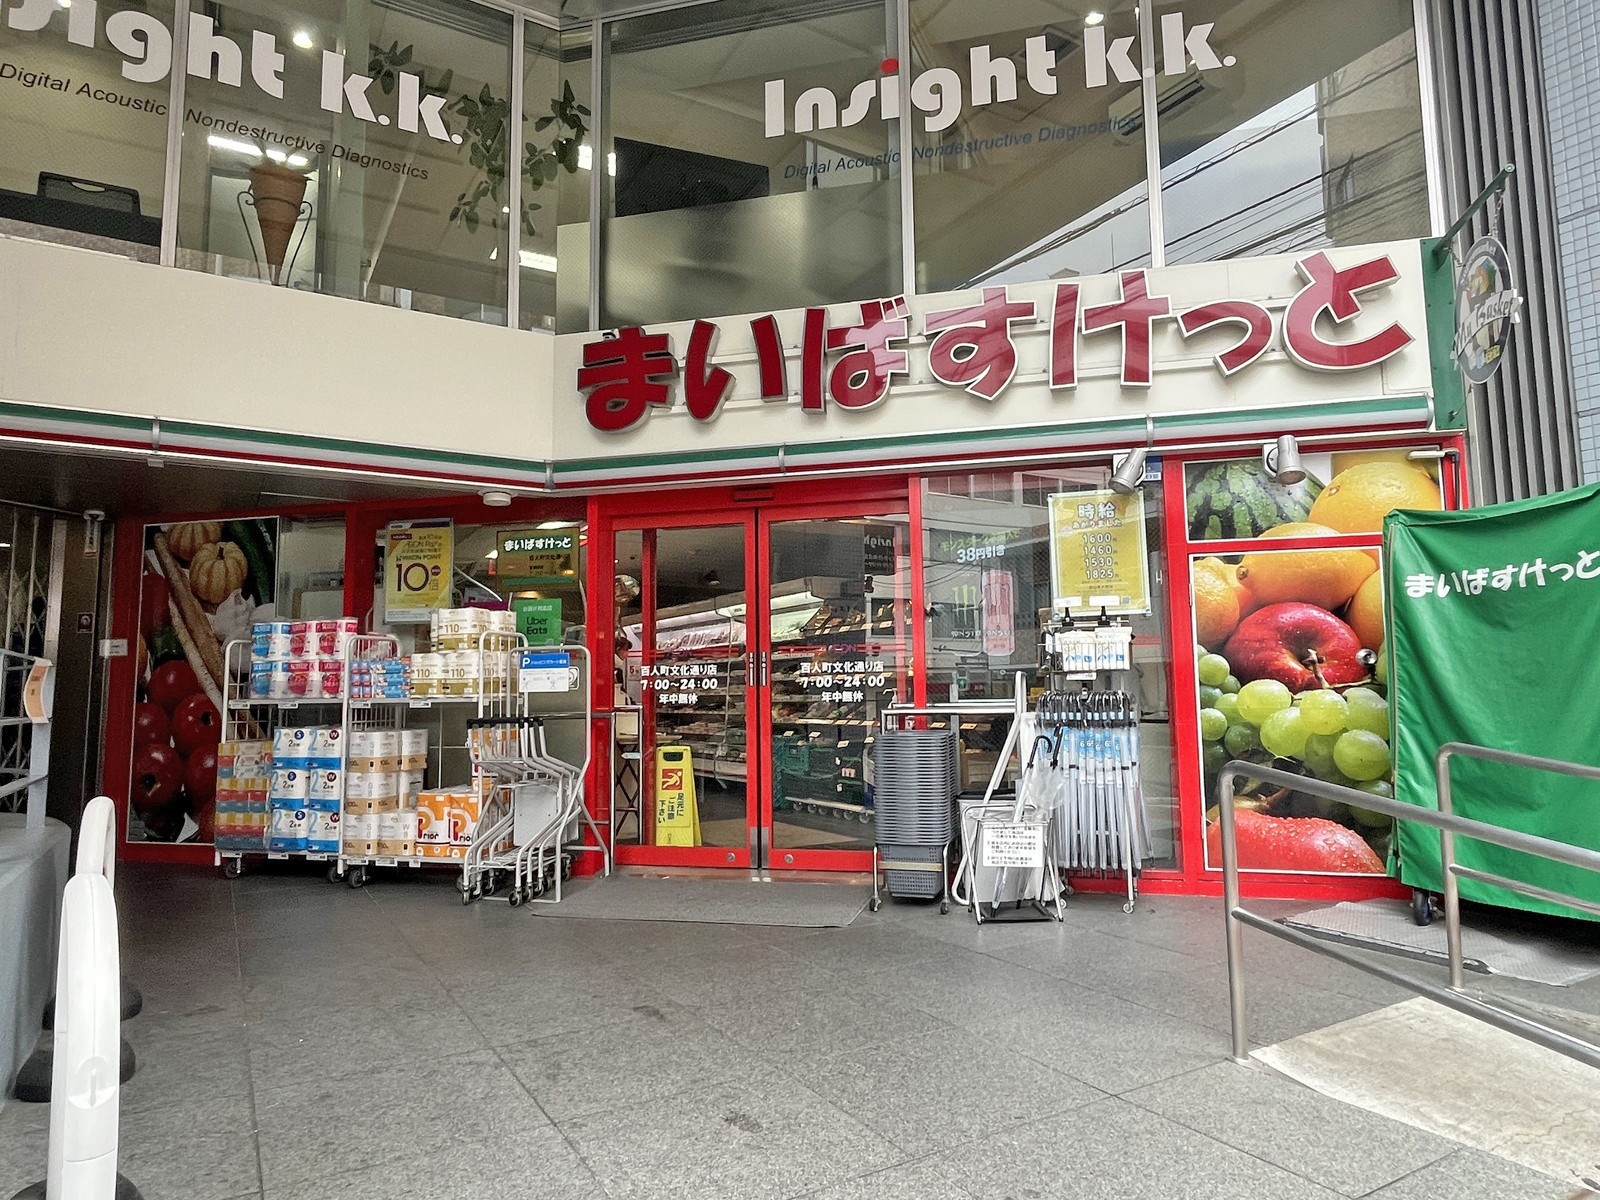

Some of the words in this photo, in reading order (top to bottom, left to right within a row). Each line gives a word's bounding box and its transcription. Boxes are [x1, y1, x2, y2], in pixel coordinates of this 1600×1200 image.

[764, 36, 1058, 138] Insight
[1083, 12, 1237, 89] k.k.
[321, 50, 464, 145] k.k.
[0, 63, 71, 92] Digital
[76, 83, 168, 116] Acoustic
[186, 108, 326, 154] Nondestructive
[332, 144, 430, 181] Diagnostics
[784, 157, 832, 180] Digital
[835, 149, 901, 172] Acoustic
[913, 131, 1033, 160] Nondestructive
[1038, 114, 1138, 143] Diagnostics
[577, 251, 1415, 432] まいばすけっと
[1078, 501, 1117, 520] 時給
[504, 536, 572, 551] まいばすけっと
[1404, 550, 1600, 599] まいばすけっと
[444, 623, 460, 633] 110
[526, 616, 548, 625] Uber
[526, 626, 548, 635] Eats
[416, 668, 430, 678] 110
[451, 668, 465, 678] 110
[640, 664, 718, 676] 百人町文化通り店
[800, 661, 885, 674] 百人町文化通り店
[658, 693, 699, 705] 年中無休
[821, 690, 864, 702] 年中無休
[657, 799, 667, 824] 下さい
[677, 792, 685, 817] 足元に
[452, 813, 472, 842] Prio
